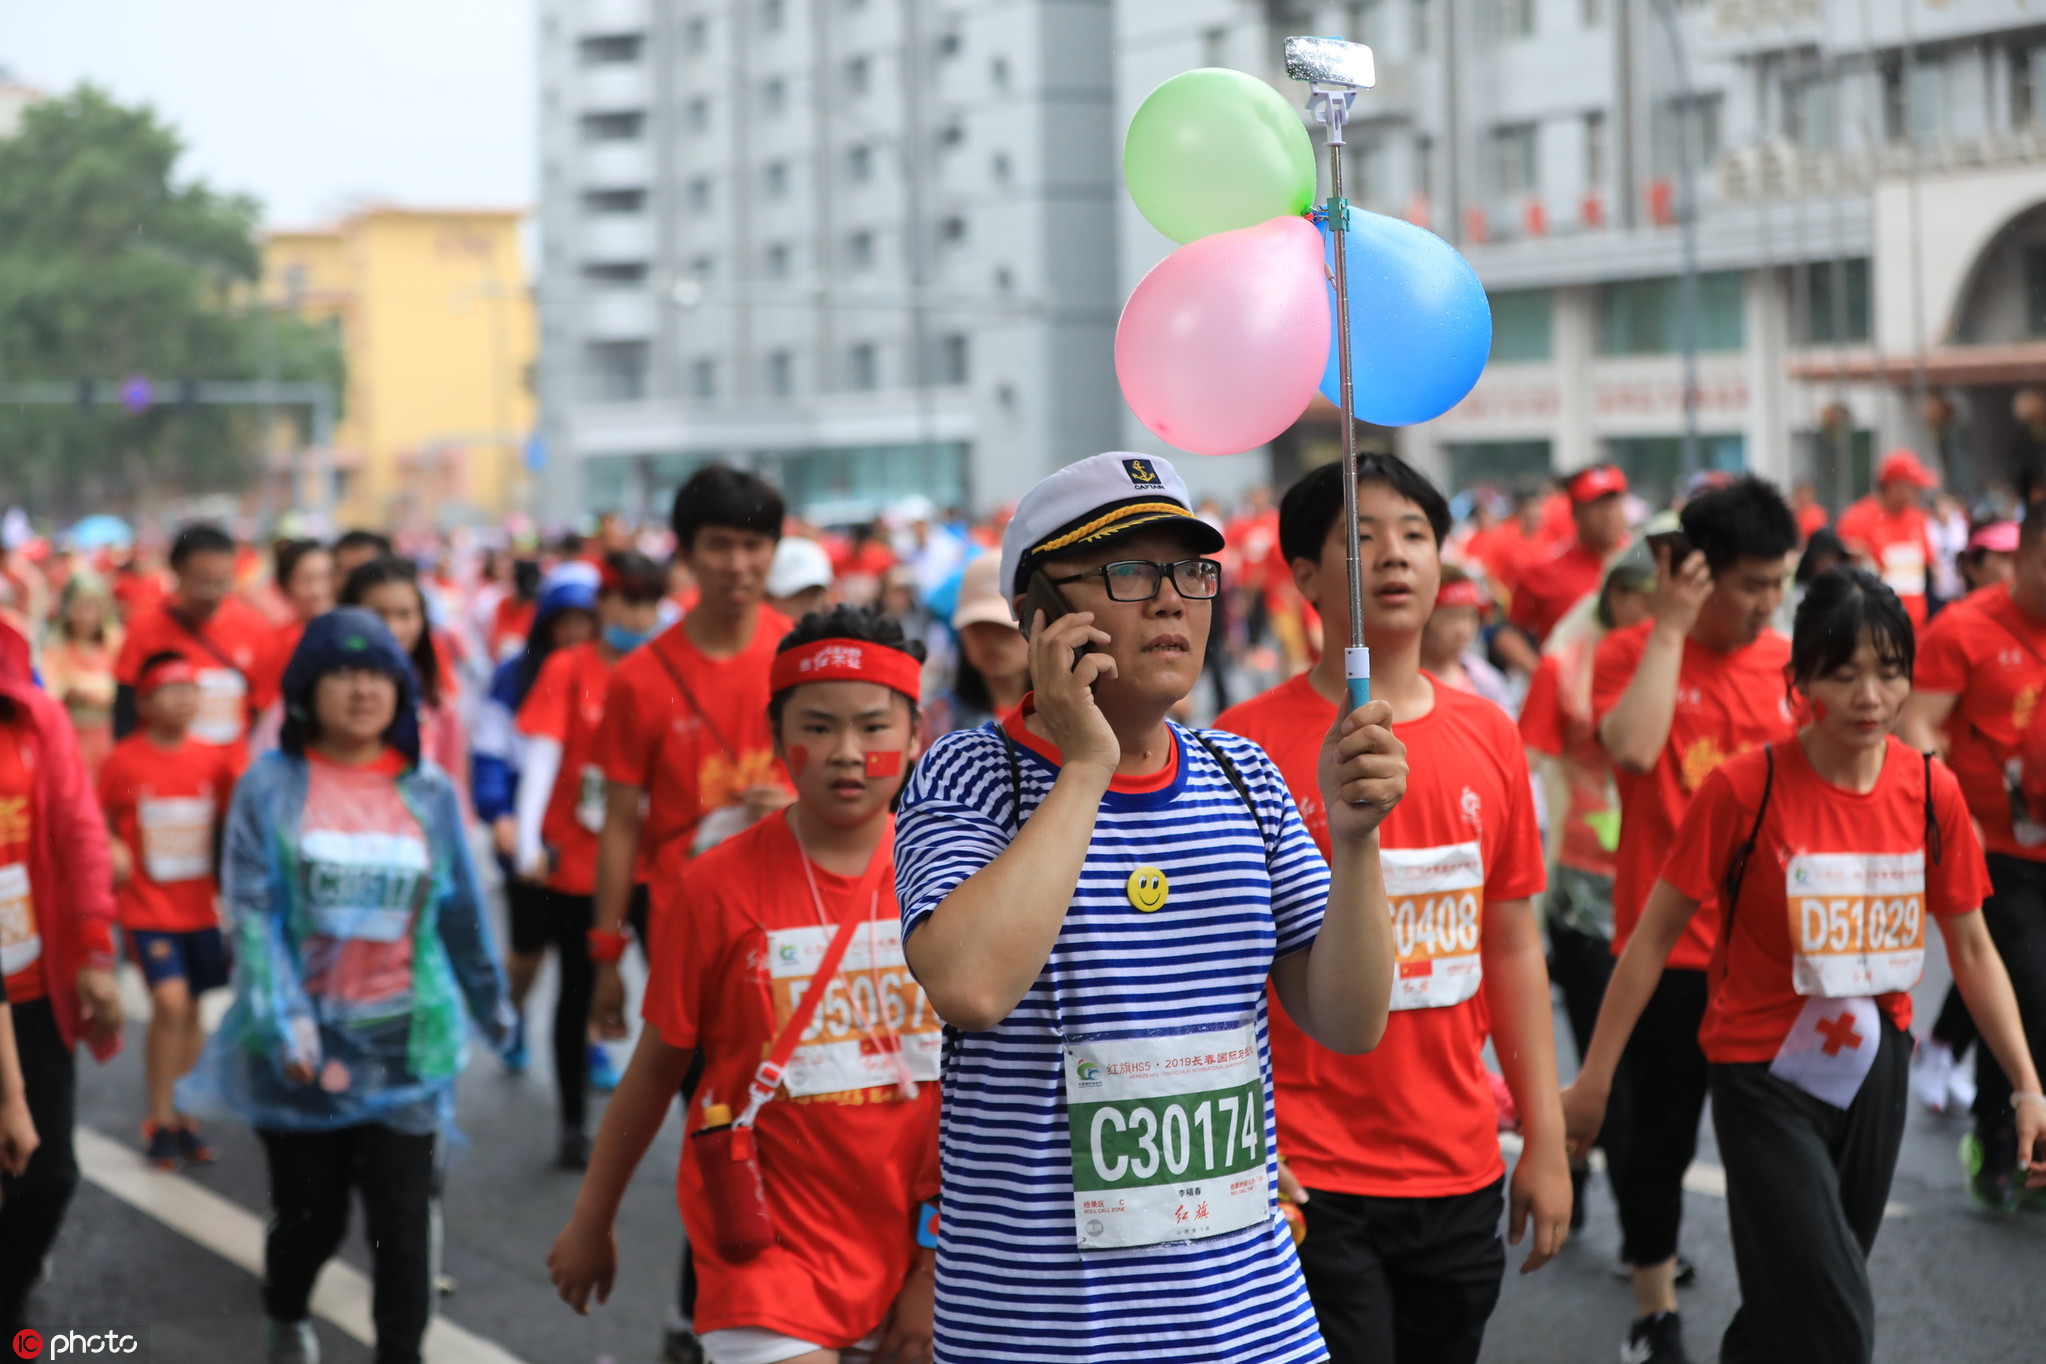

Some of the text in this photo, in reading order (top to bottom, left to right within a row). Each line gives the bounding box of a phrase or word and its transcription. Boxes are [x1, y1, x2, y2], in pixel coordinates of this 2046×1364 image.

[1388, 893, 1478, 957] 0408
[1801, 897, 1920, 951] D51029
[1090, 1091, 1258, 1182] C30174
[1174, 1200, 1210, 1224] 红旗
